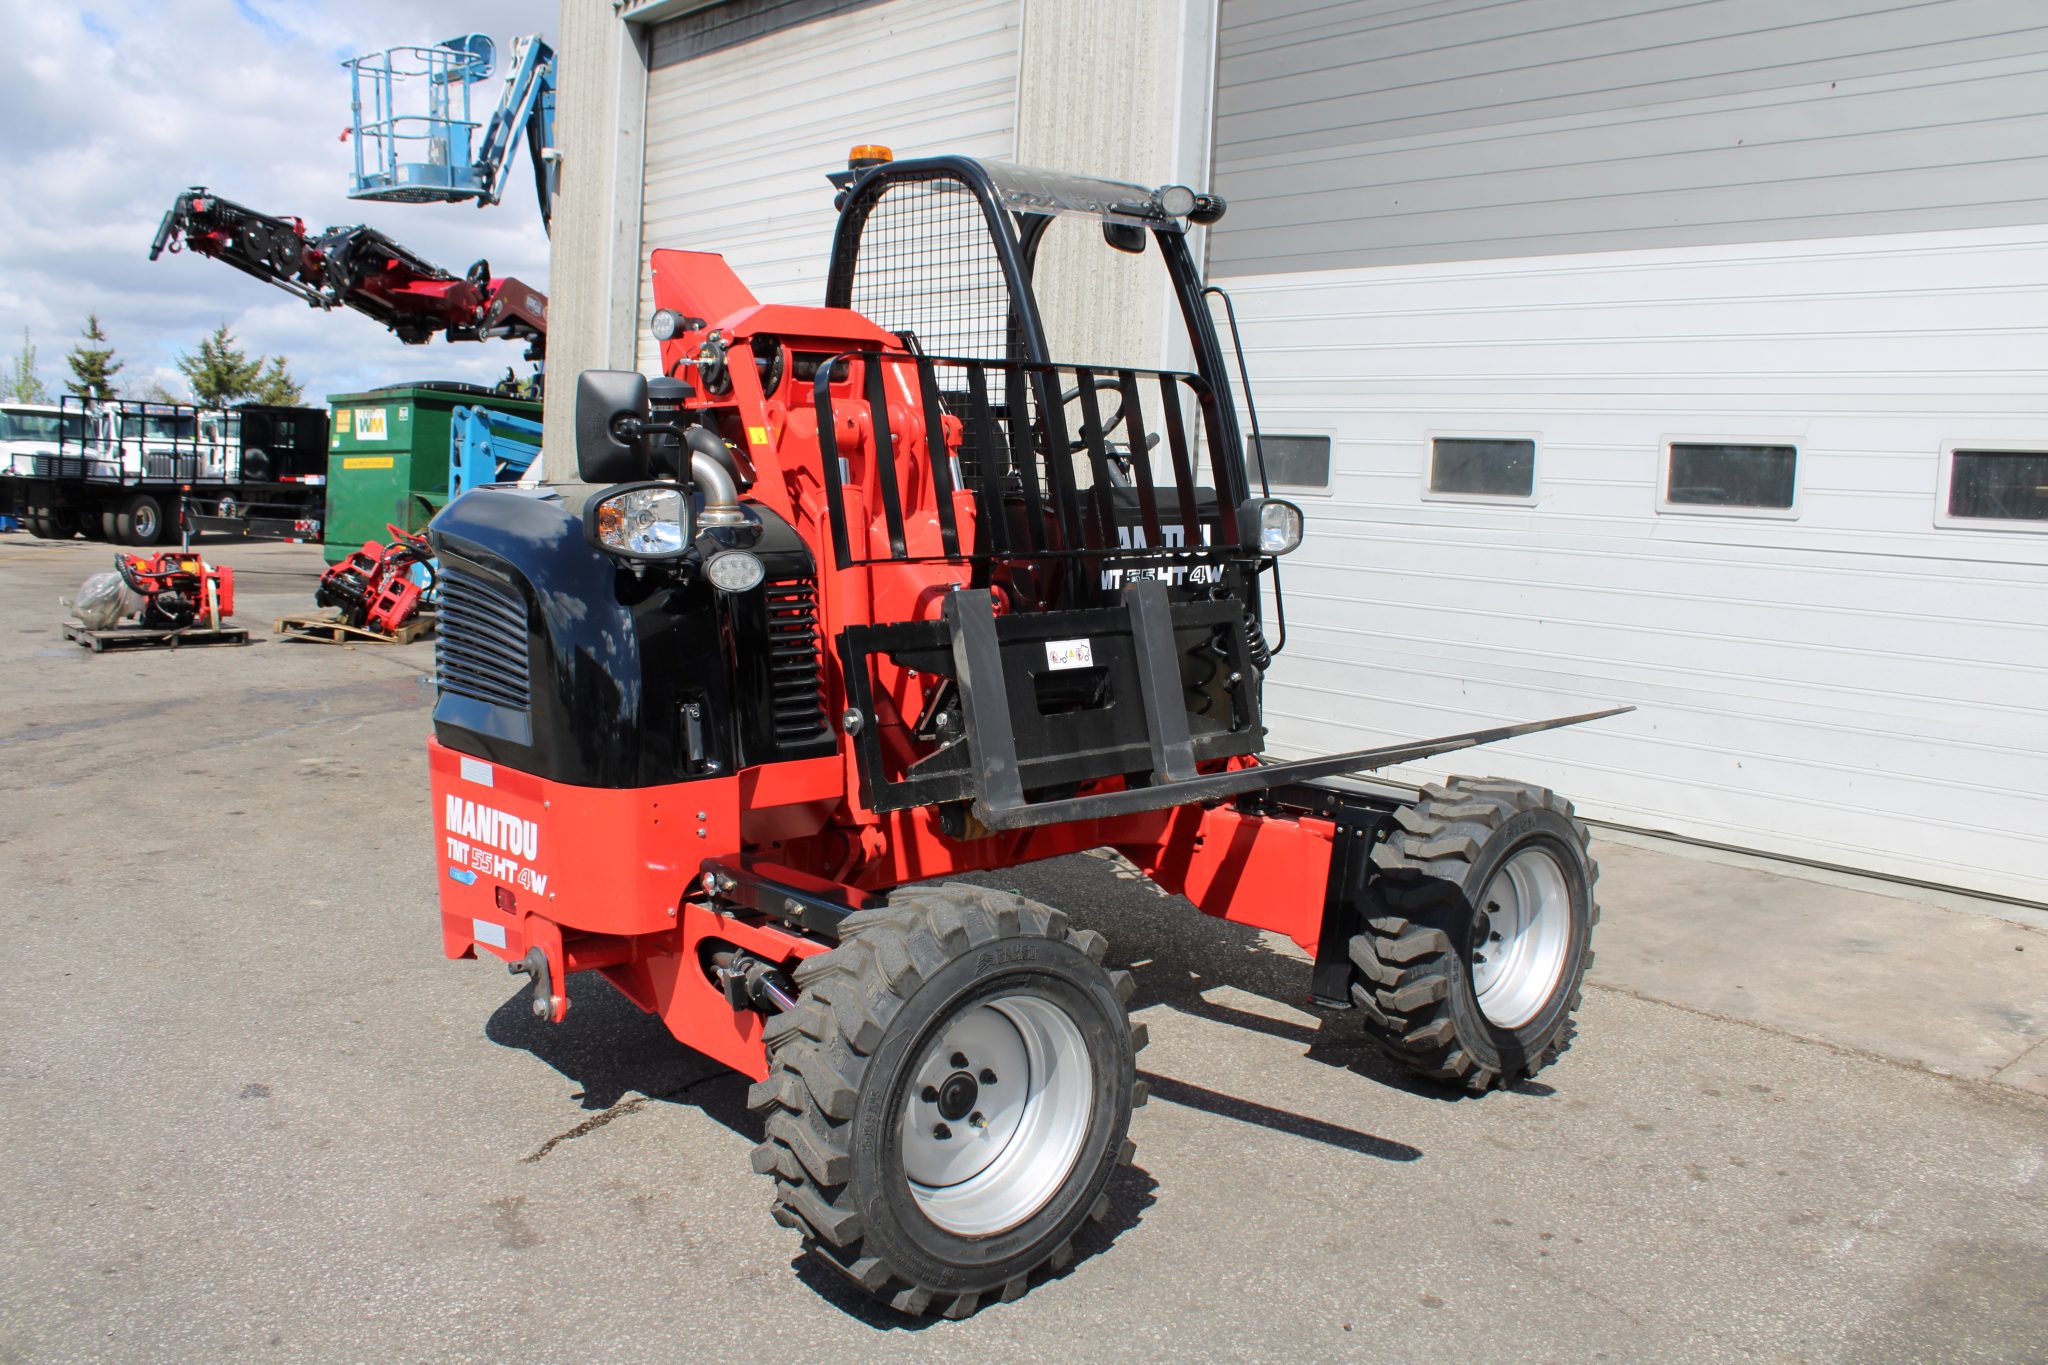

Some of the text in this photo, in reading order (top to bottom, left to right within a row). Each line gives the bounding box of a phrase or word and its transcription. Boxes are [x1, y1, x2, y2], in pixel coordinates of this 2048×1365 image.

[359, 418, 384, 433] WM
[445, 793, 538, 862] MANITOU
[446, 836, 470, 865] TMT
[471, 847, 493, 875] 55
[493, 854, 519, 884] HT
[517, 867, 548, 896] 4W
